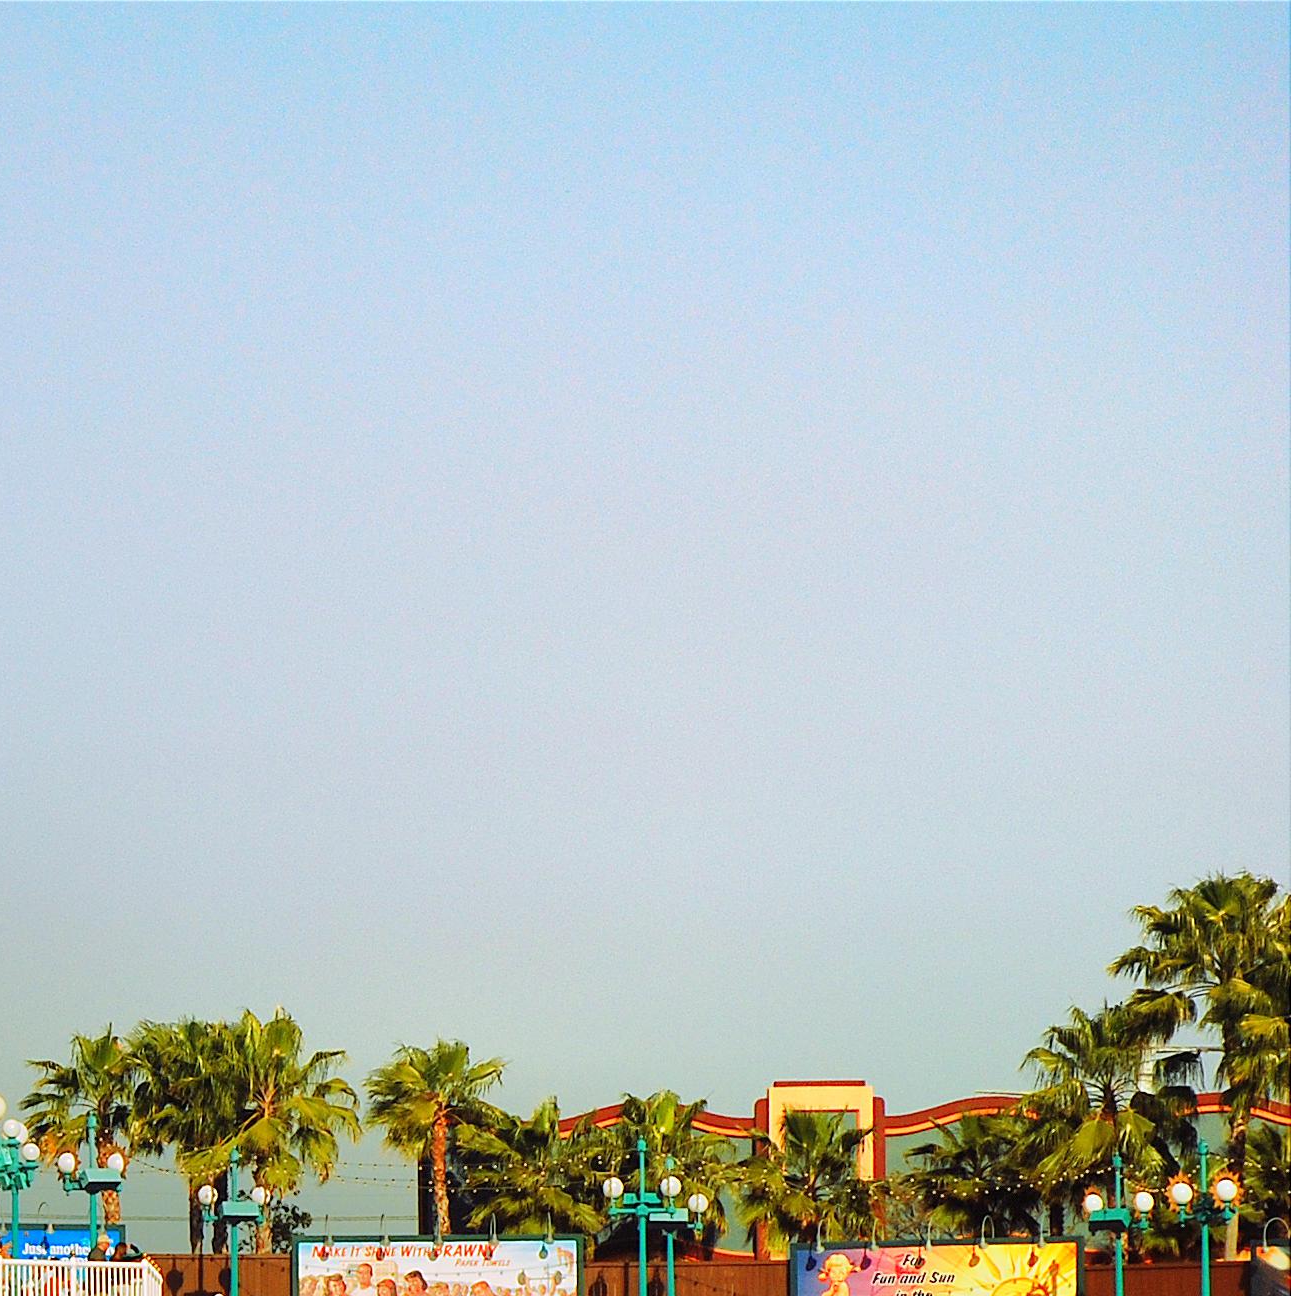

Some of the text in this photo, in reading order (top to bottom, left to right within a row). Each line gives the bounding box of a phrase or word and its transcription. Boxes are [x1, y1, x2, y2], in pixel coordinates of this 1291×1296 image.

[50, 1243, 91, 1255] anothe
[872, 1271, 955, 1284] Fun and Sun
